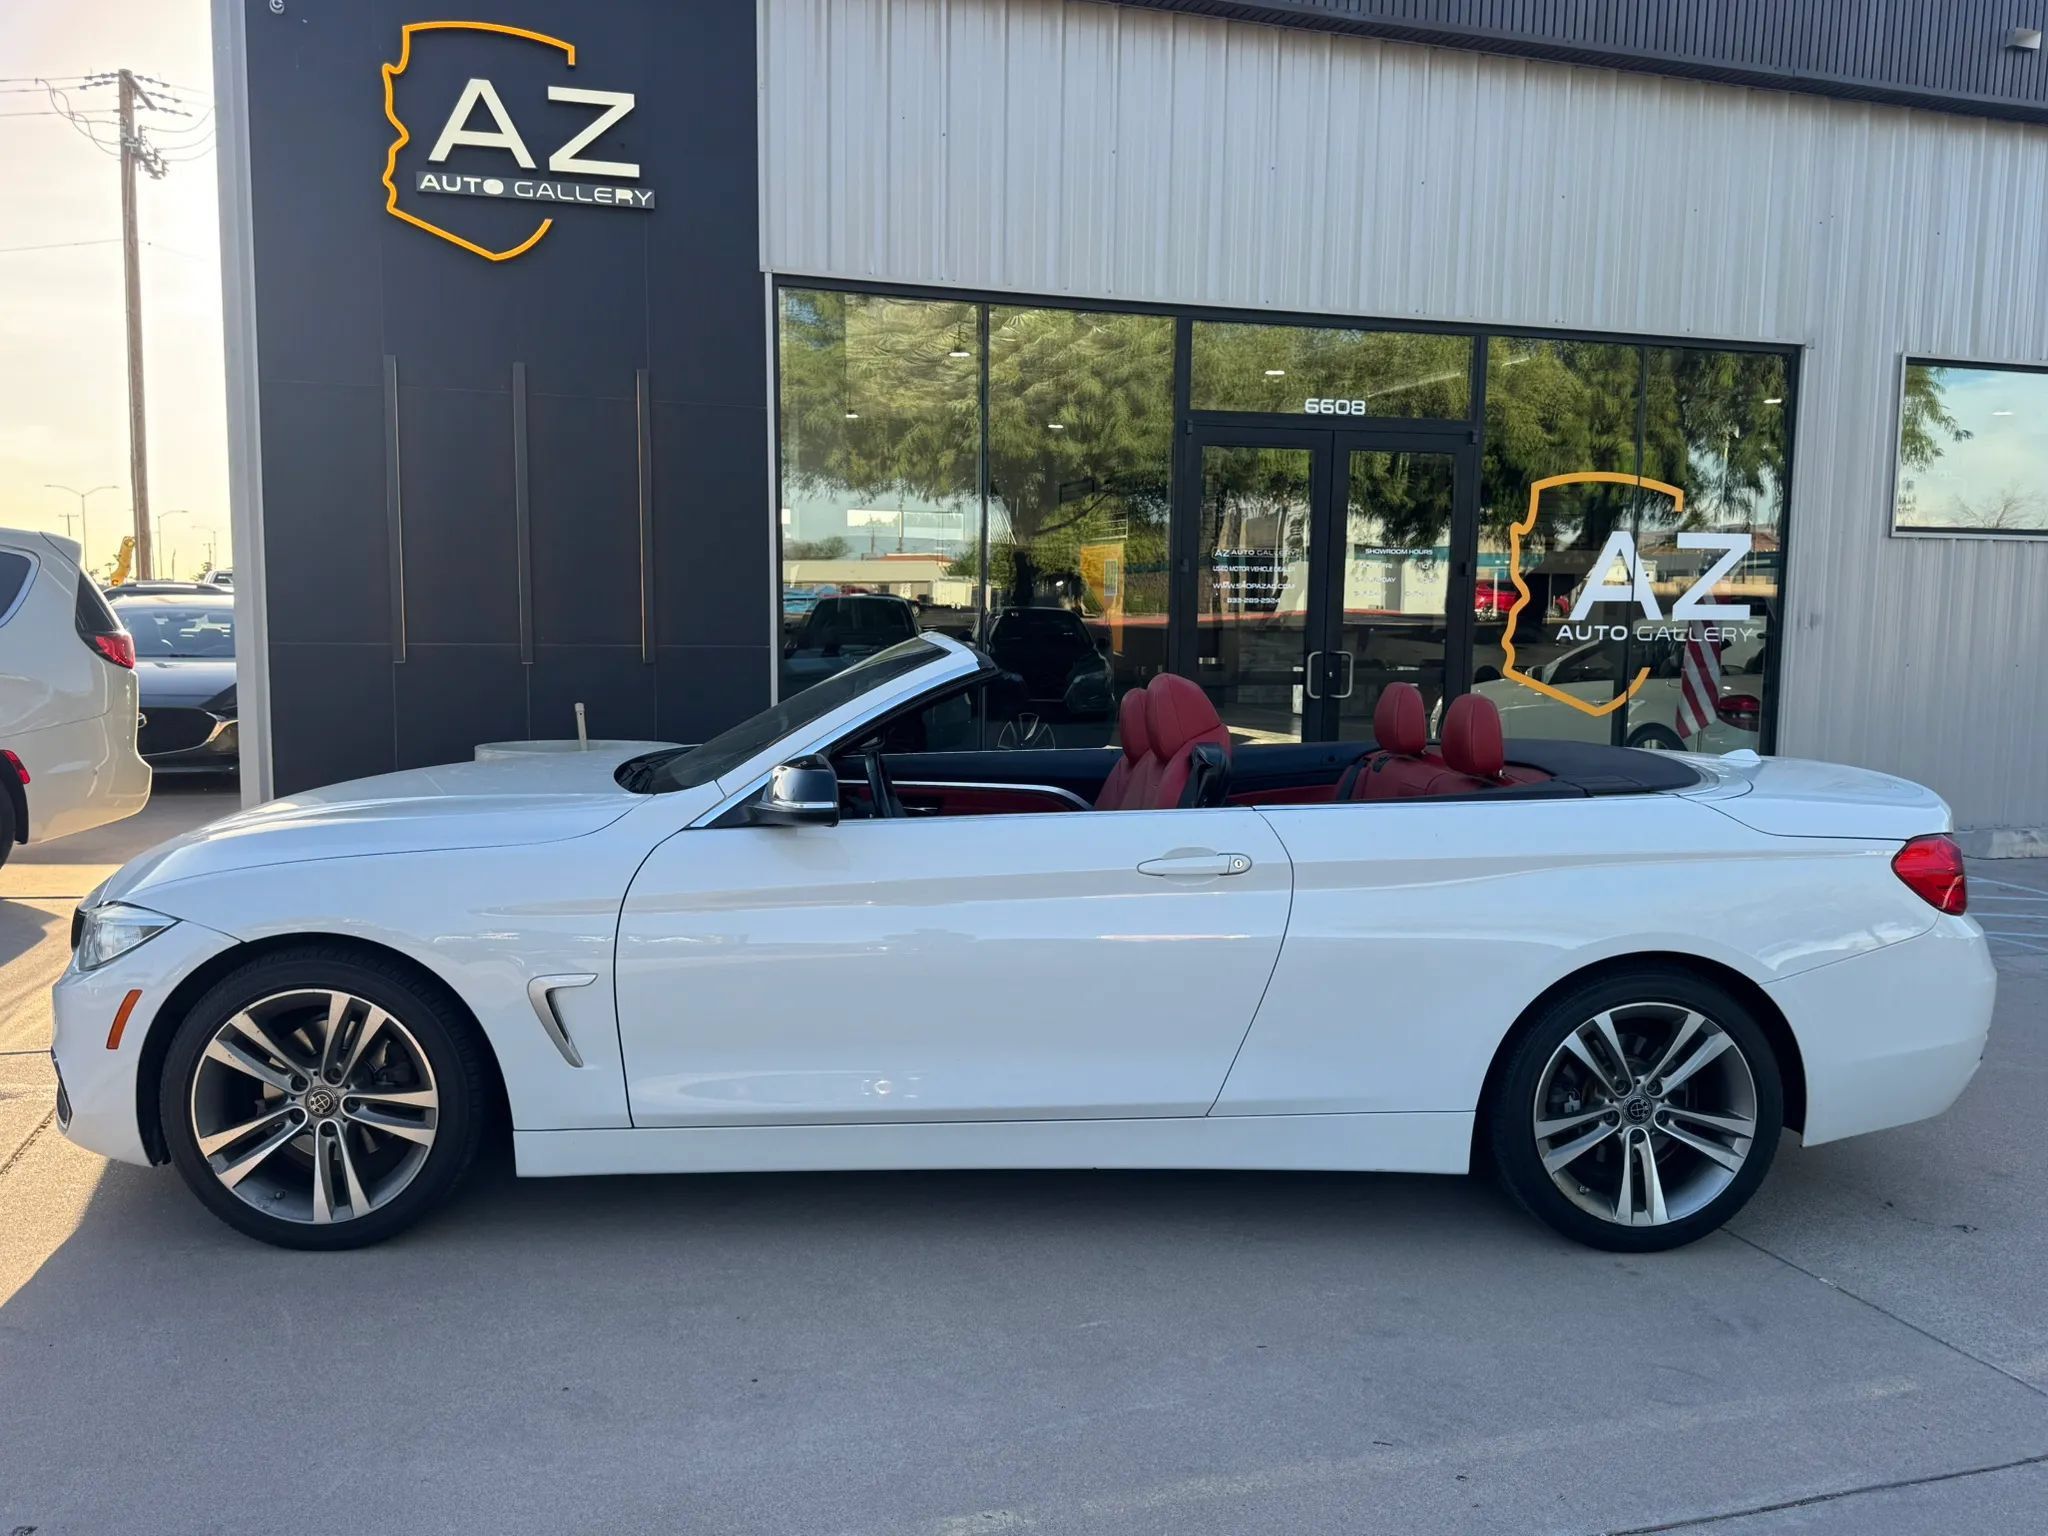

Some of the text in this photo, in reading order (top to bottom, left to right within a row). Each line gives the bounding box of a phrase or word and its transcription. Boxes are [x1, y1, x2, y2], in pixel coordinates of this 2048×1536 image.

[428, 78, 640, 178] AZ
[420, 174, 653, 206] AUTO GALLERY
[1305, 398, 1366, 416] 6608
[1568, 531, 1752, 621] AZ
[1556, 625, 1753, 642] AUTO GALLERY
